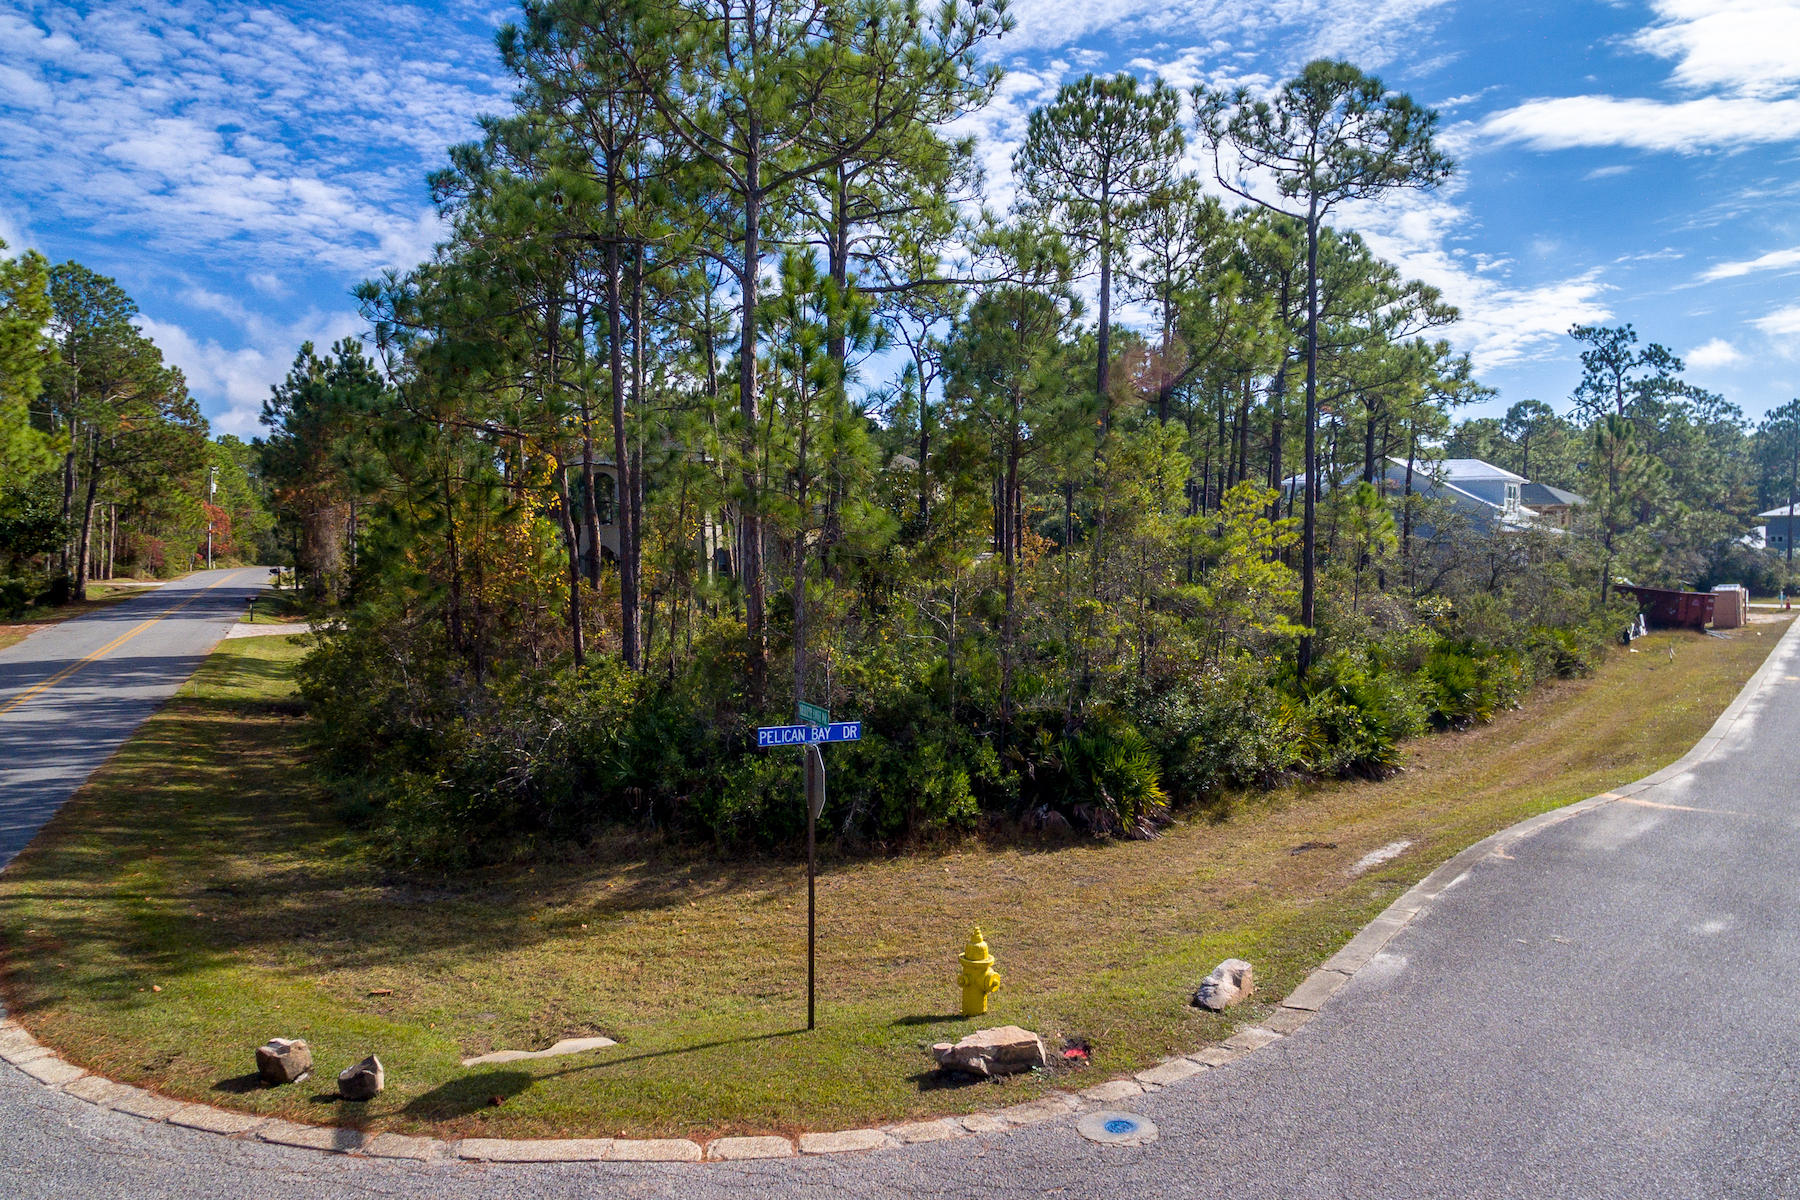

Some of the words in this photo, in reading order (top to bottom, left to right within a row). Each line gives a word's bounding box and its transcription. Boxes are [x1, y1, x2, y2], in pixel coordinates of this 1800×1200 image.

[759, 729, 805, 744] PELICAN
[811, 727, 831, 740] BAY
[843, 725, 857, 739] DR
